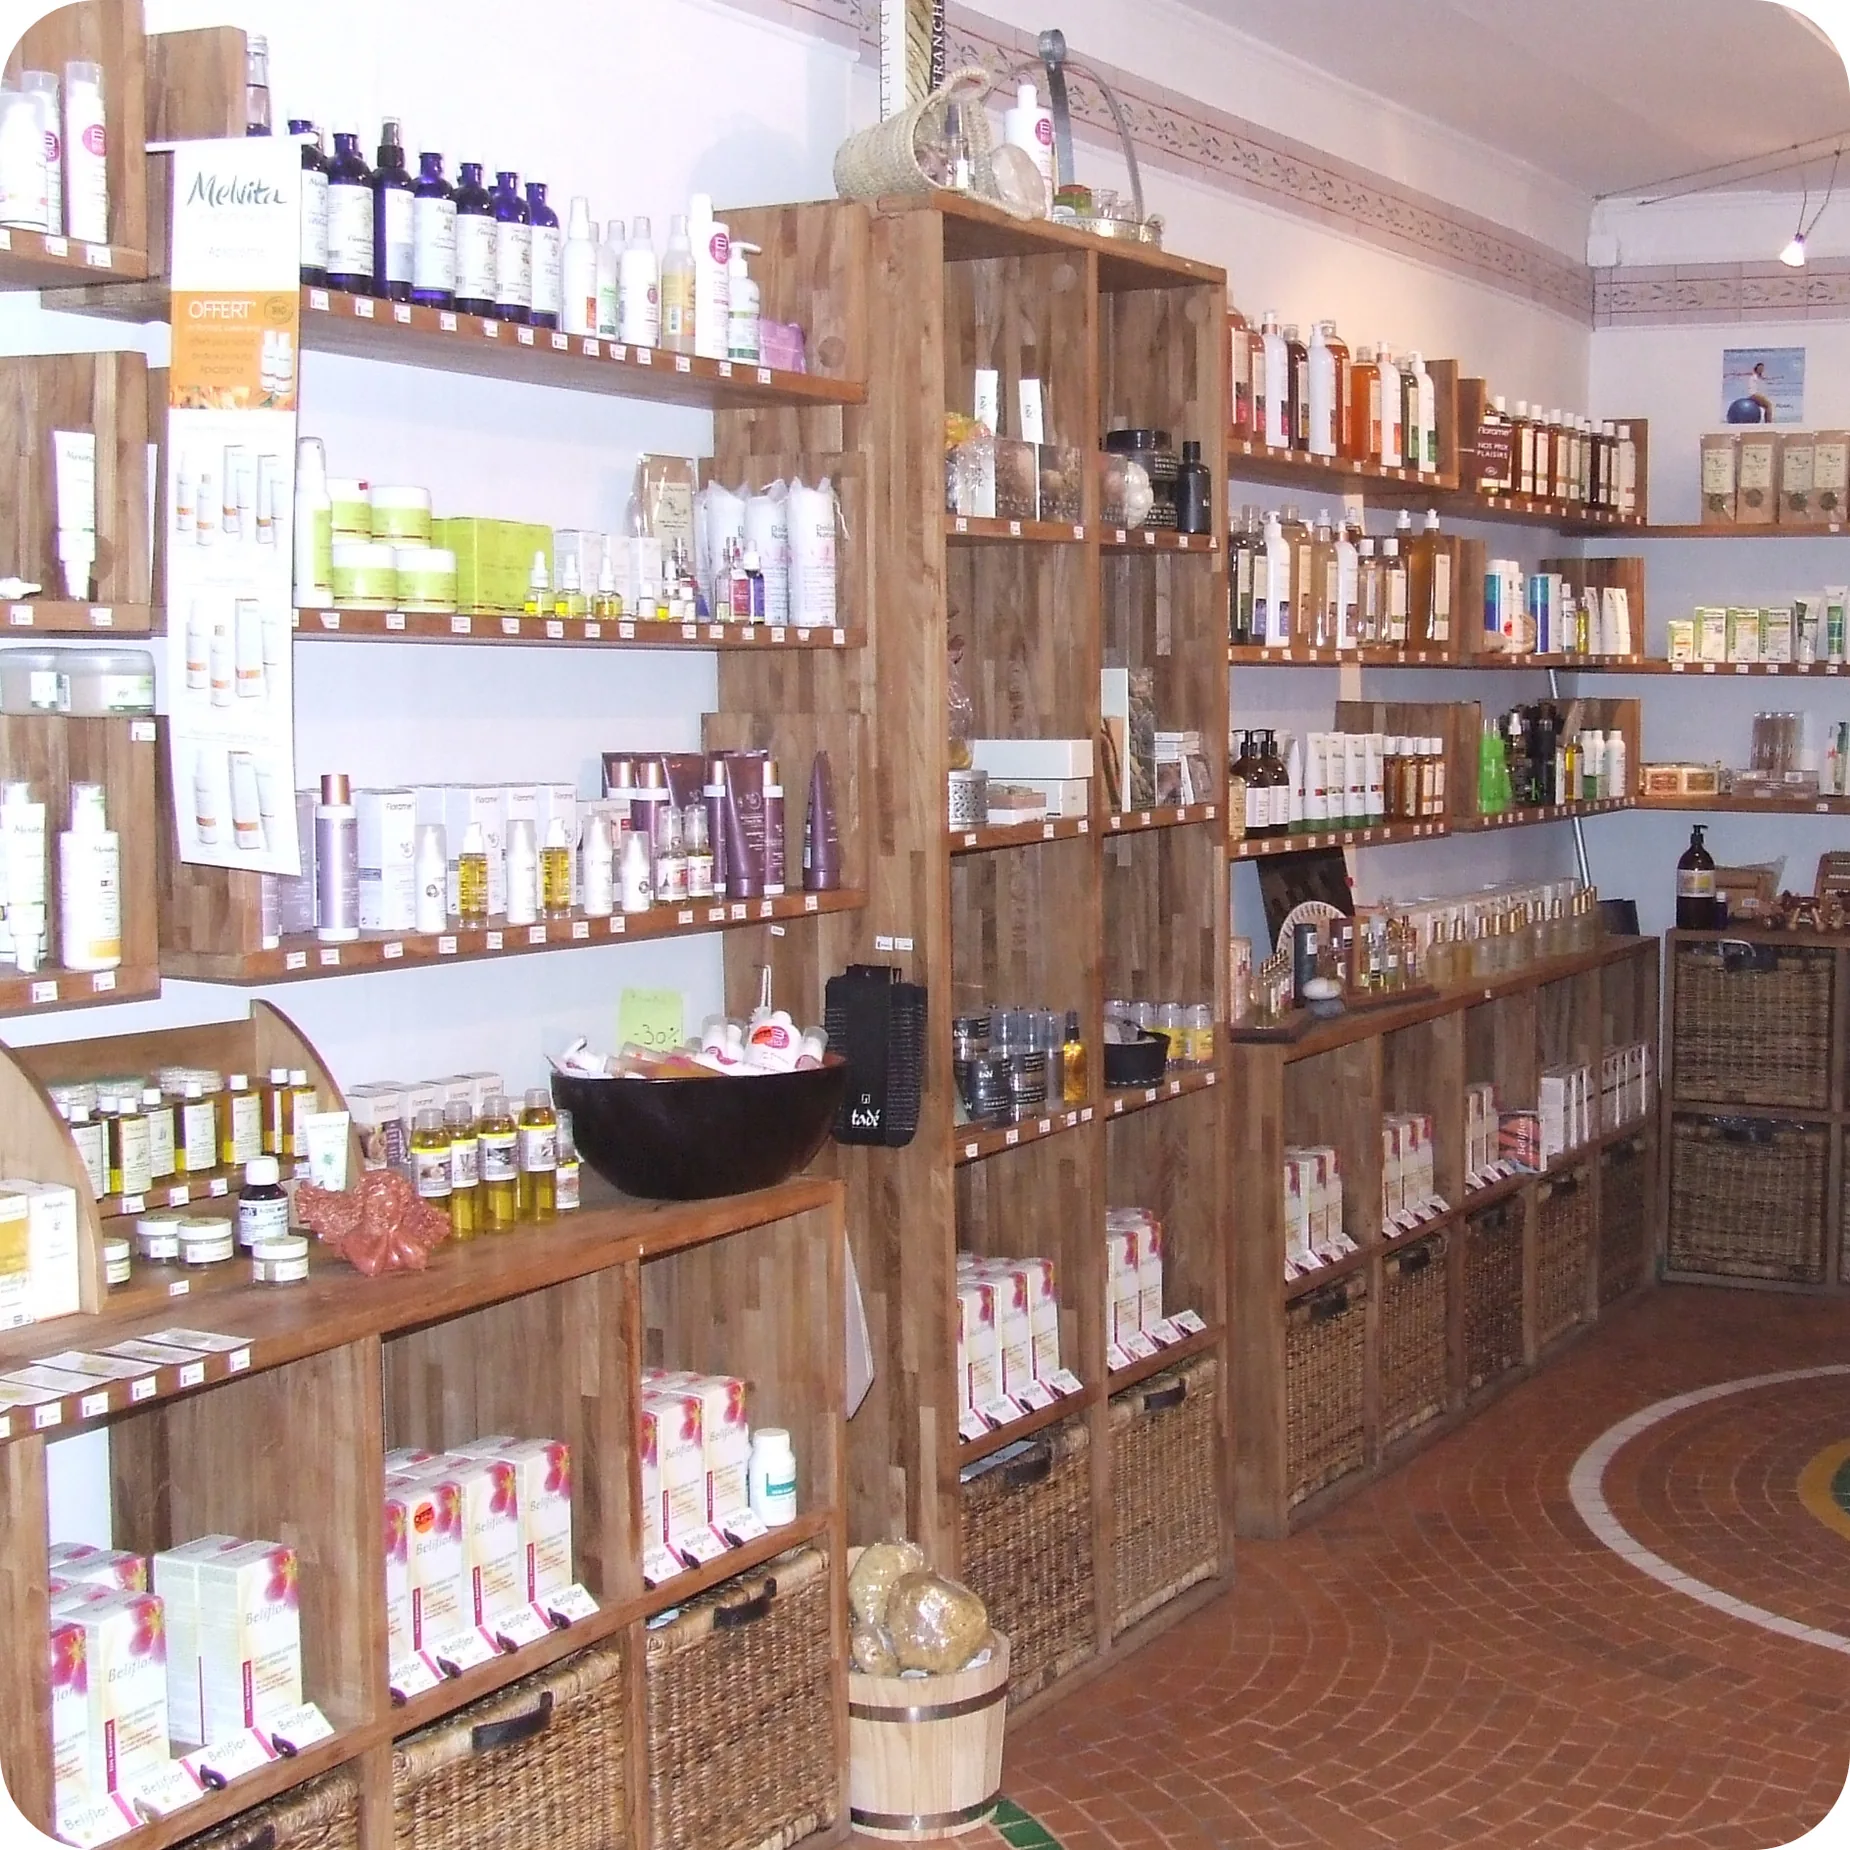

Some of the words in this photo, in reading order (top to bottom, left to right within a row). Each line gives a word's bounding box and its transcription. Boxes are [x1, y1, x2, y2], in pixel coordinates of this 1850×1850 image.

[931, 0, 945, 89] TRANCH
[880, 92, 891, 116] TR
[187, 171, 287, 208] Melvita
[633, 1023, 680, 1045] -30%
